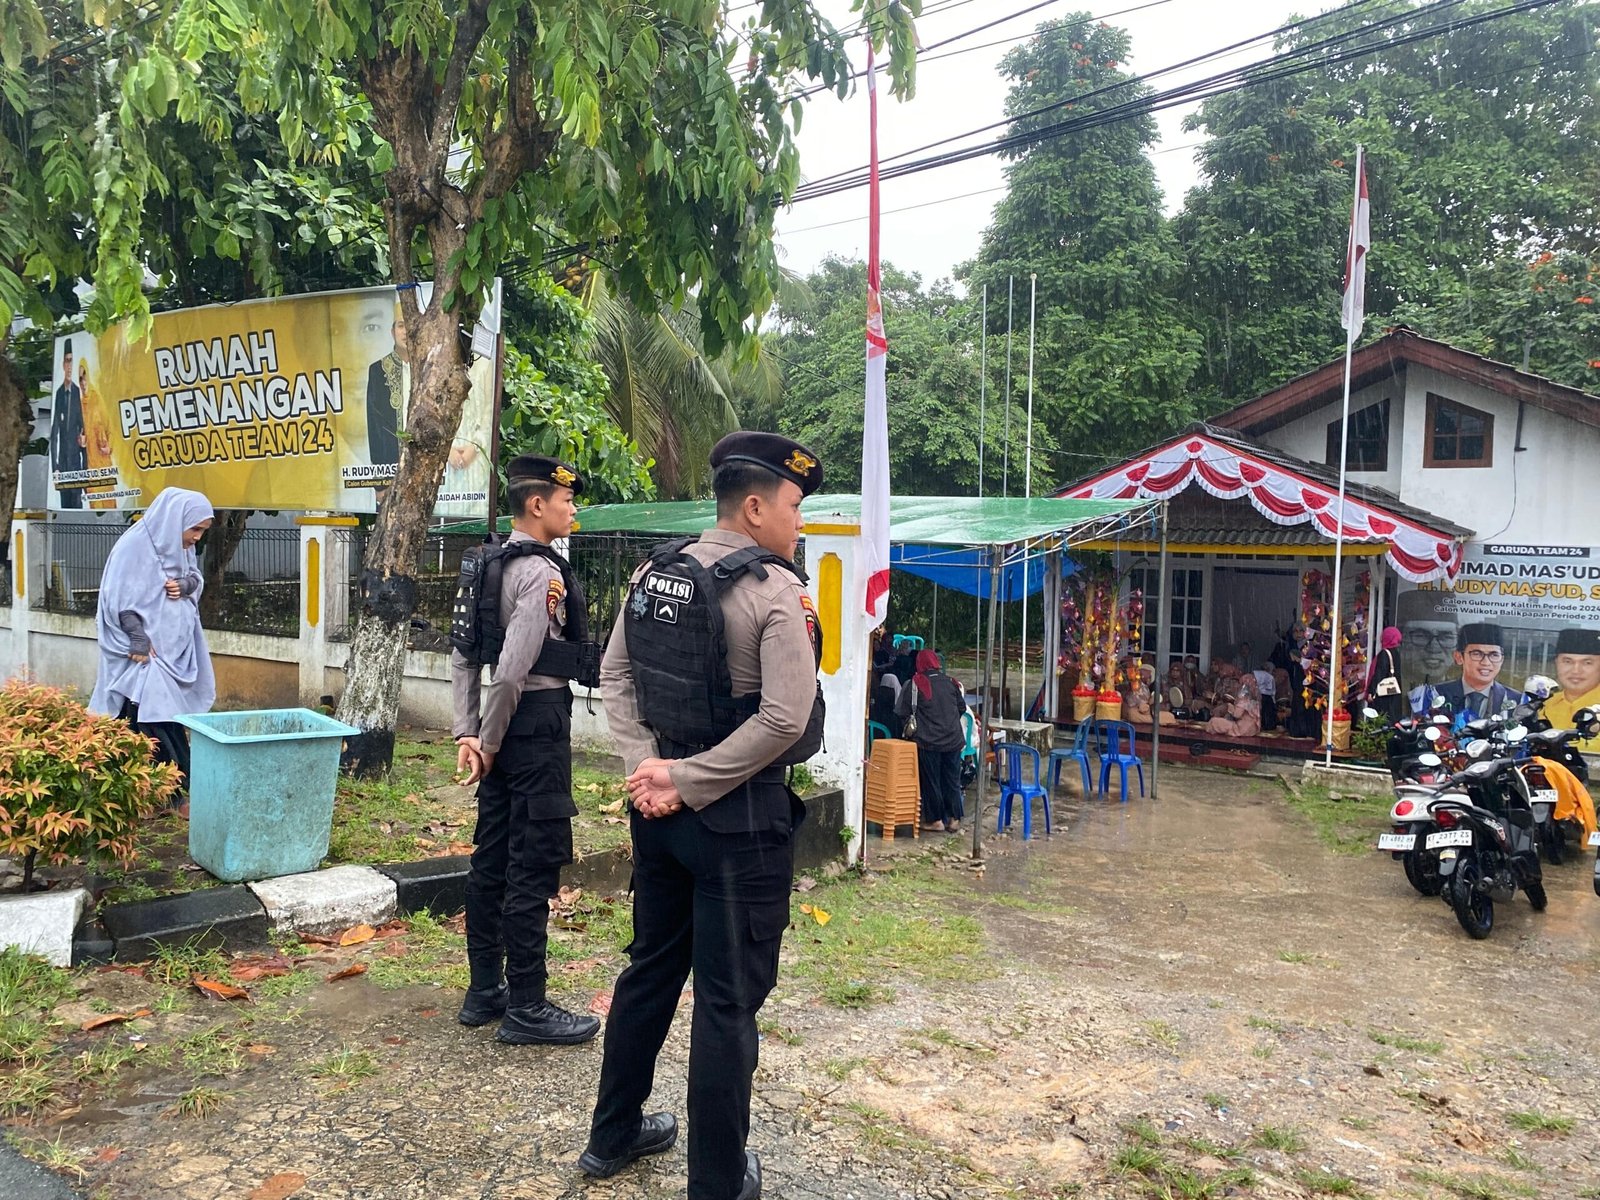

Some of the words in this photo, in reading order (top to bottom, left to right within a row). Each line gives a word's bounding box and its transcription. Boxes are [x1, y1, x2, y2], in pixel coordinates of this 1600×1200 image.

[155, 329, 278, 388] RUMAH
[119, 368, 343, 438] PEMENANGAN
[133, 430, 228, 468] GARUDA
[226, 421, 299, 461] TEAM
[301, 418, 334, 454] 24
[342, 468, 350, 477] H.
[352, 466, 376, 477] RUDY
[377, 465, 397, 476] MAS
[462, 493, 486, 501] ABIDIN
[1490, 545, 1535, 555] GARUDA
[1537, 547, 1568, 556] TEAM
[1570, 548, 1583, 556] 24
[648, 575, 691, 599] POLISI
[1500, 581, 1587, 602] MAS'UD,
[1434, 605, 1458, 613] Calon
[1460, 607, 1499, 616] Walikota
[1500, 609, 1549, 619] Balikpapan
[1551, 612, 1586, 620] Periode
[1469, 599, 1509, 608] Gubernur
[1543, 603, 1577, 612] Periode
